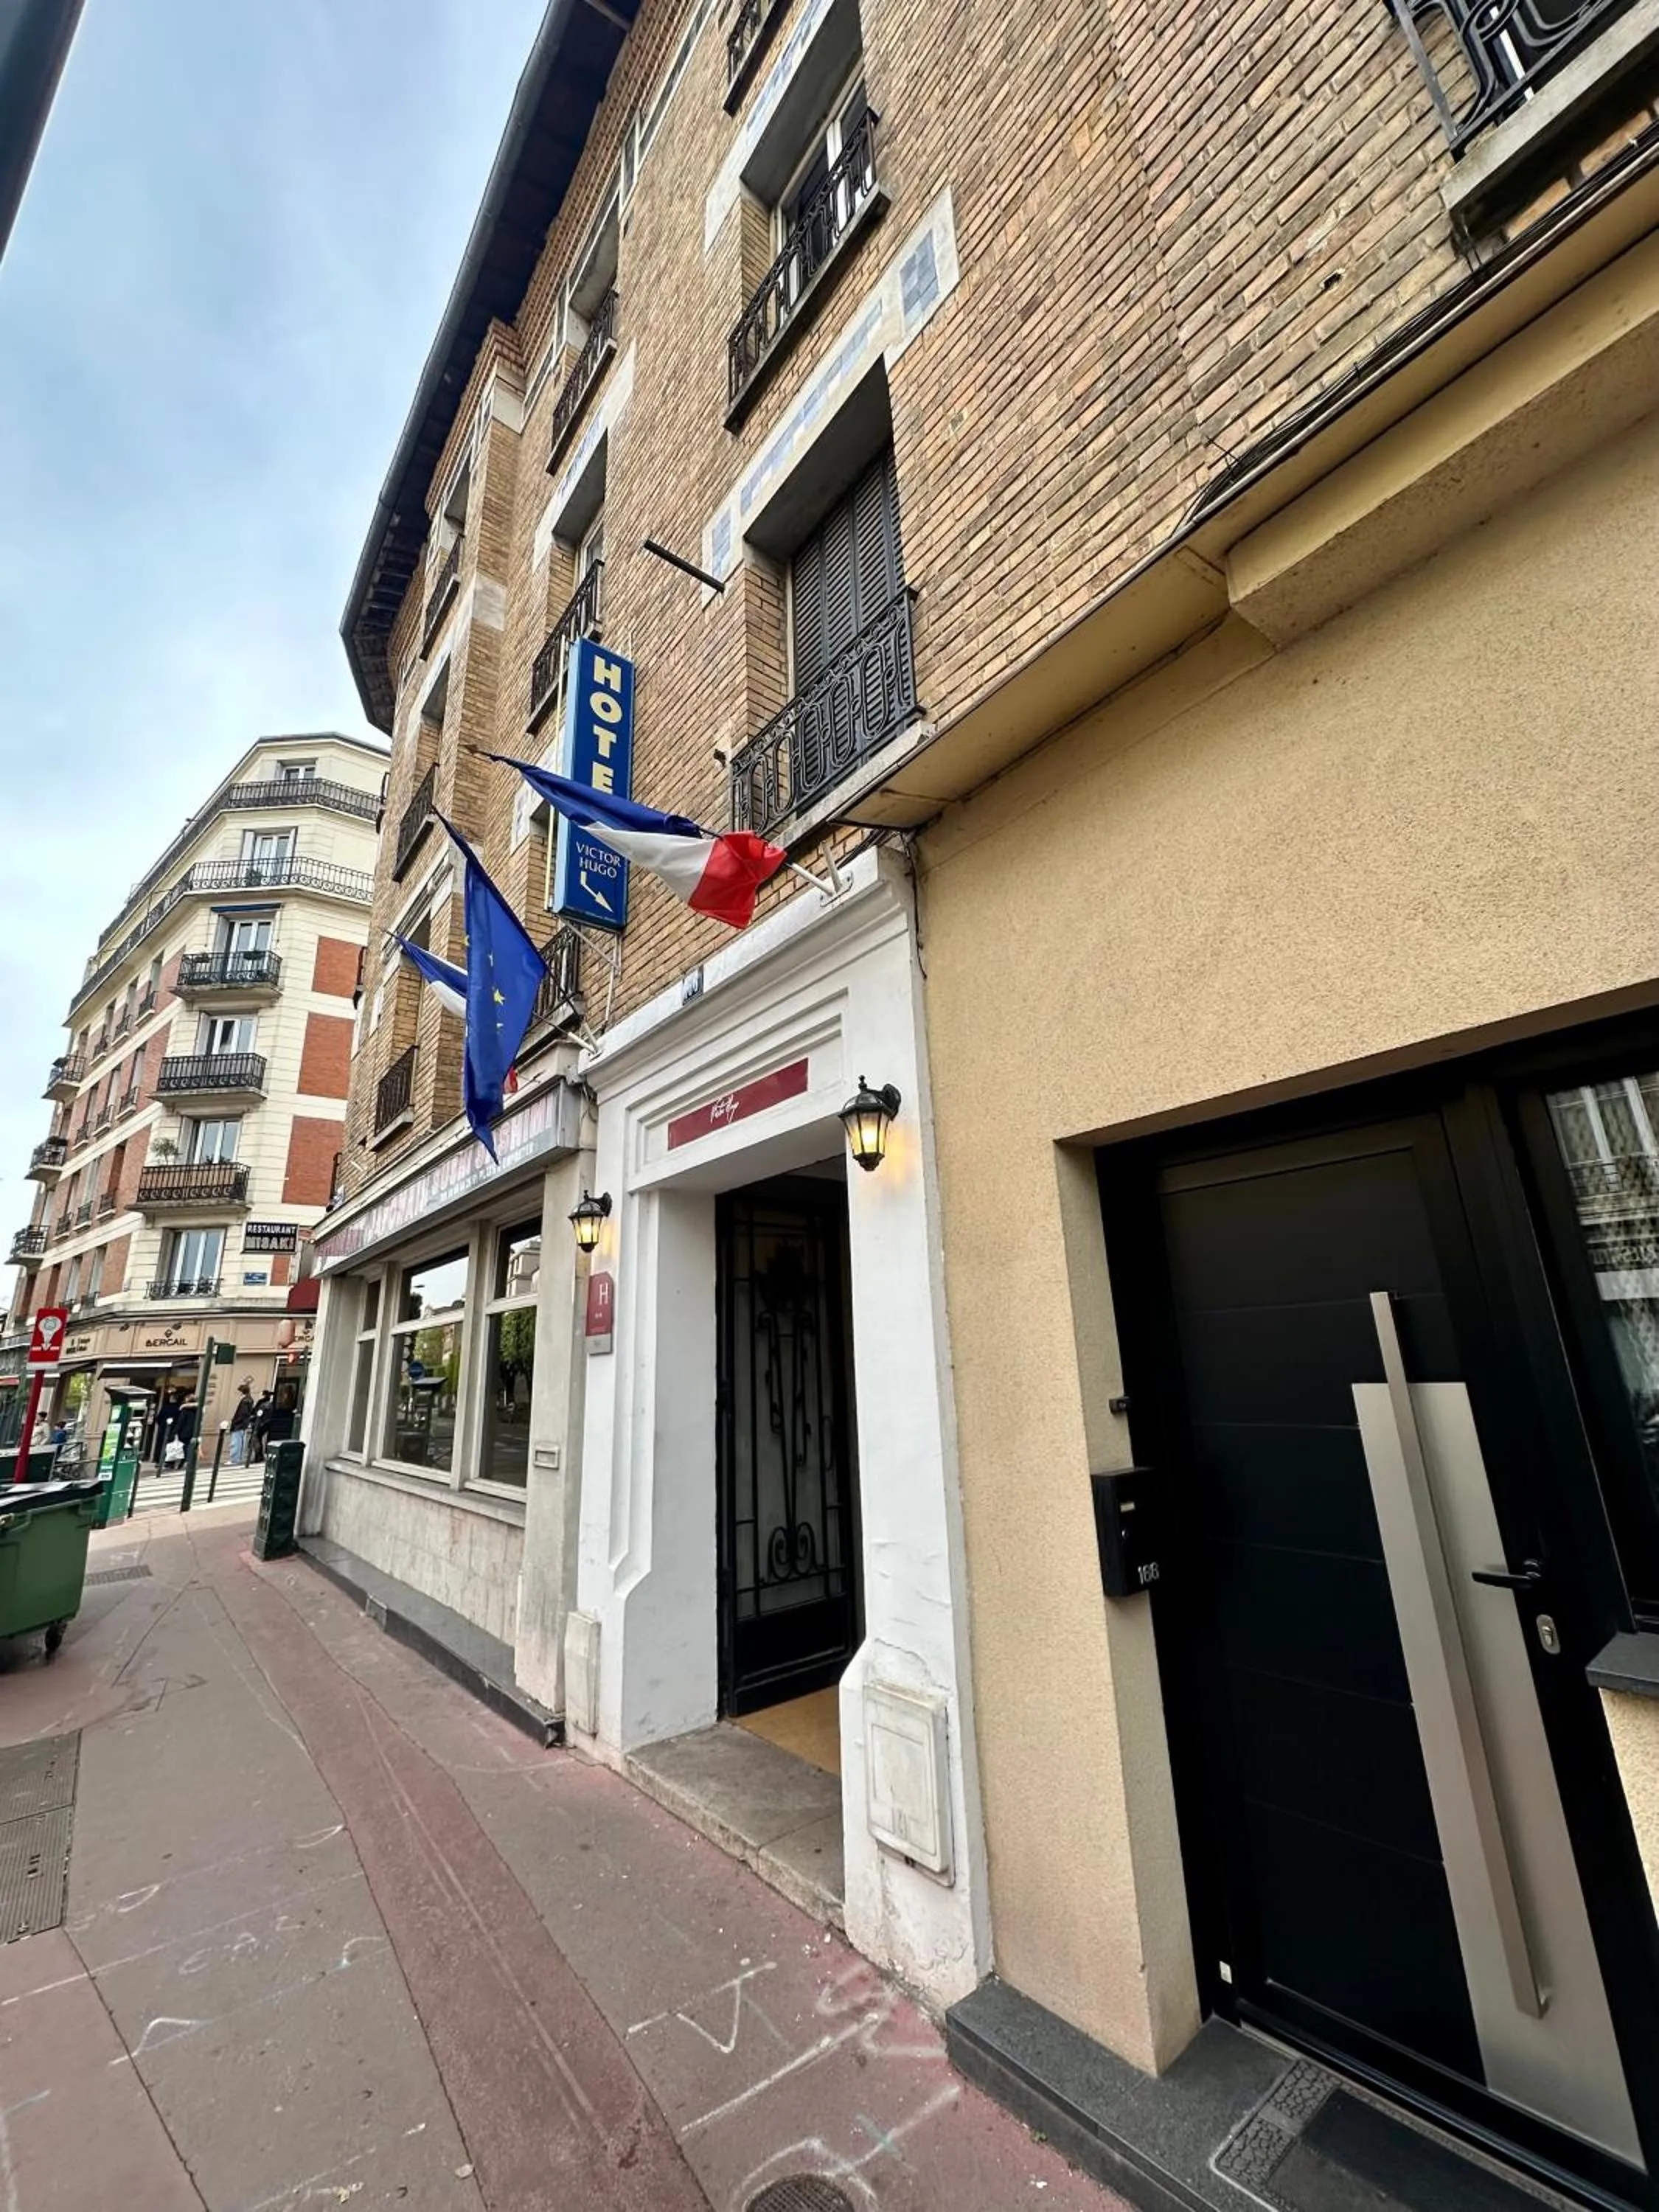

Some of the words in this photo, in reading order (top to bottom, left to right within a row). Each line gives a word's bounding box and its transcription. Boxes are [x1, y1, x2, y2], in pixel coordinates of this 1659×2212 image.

[590, 655, 623, 796] HOTE
[576, 841, 622, 868] VICTOR
[579, 856, 618, 878] HUGO
[247, 1224, 296, 1234] RESTAURANT
[599, 1282, 609, 1306] H
